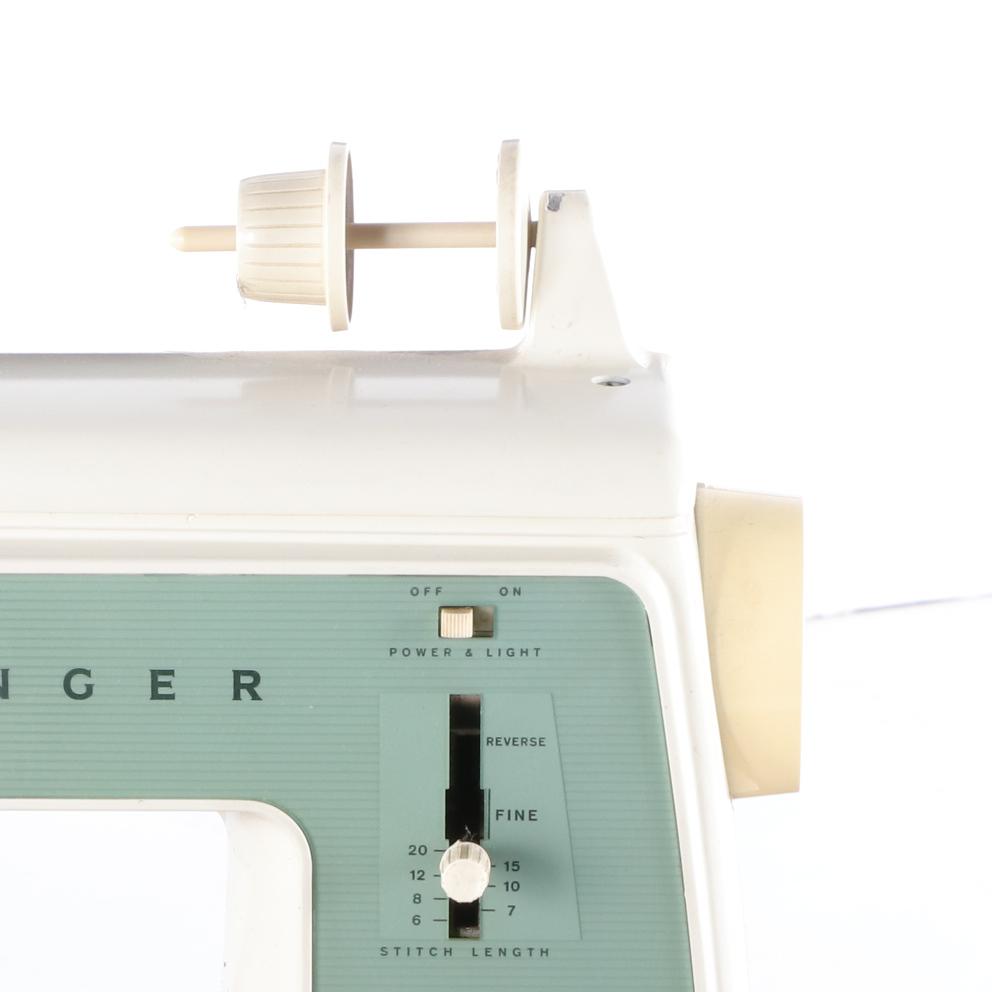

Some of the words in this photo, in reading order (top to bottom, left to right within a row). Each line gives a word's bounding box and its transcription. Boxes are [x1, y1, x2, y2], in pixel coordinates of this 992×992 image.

[410, 587, 442, 596] OFF
[499, 587, 521, 596] ON
[389, 648, 452, 657] POWER
[465, 648, 473, 657] &
[487, 648, 541, 657] LIGHT
[486, 737, 546, 747] REVERSE
[495, 809, 538, 821] FINE
[408, 845, 428, 856] 20
[504, 861, 520, 872] 15
[410, 870, 425, 881] 12
[504, 882, 520, 892] 10
[413, 893, 422, 904] 8
[508, 905, 516, 916] 7
[412, 915, 421, 926] 6
[380, 947, 453, 957] STITCH
[472, 947, 549, 957] LENGTH
